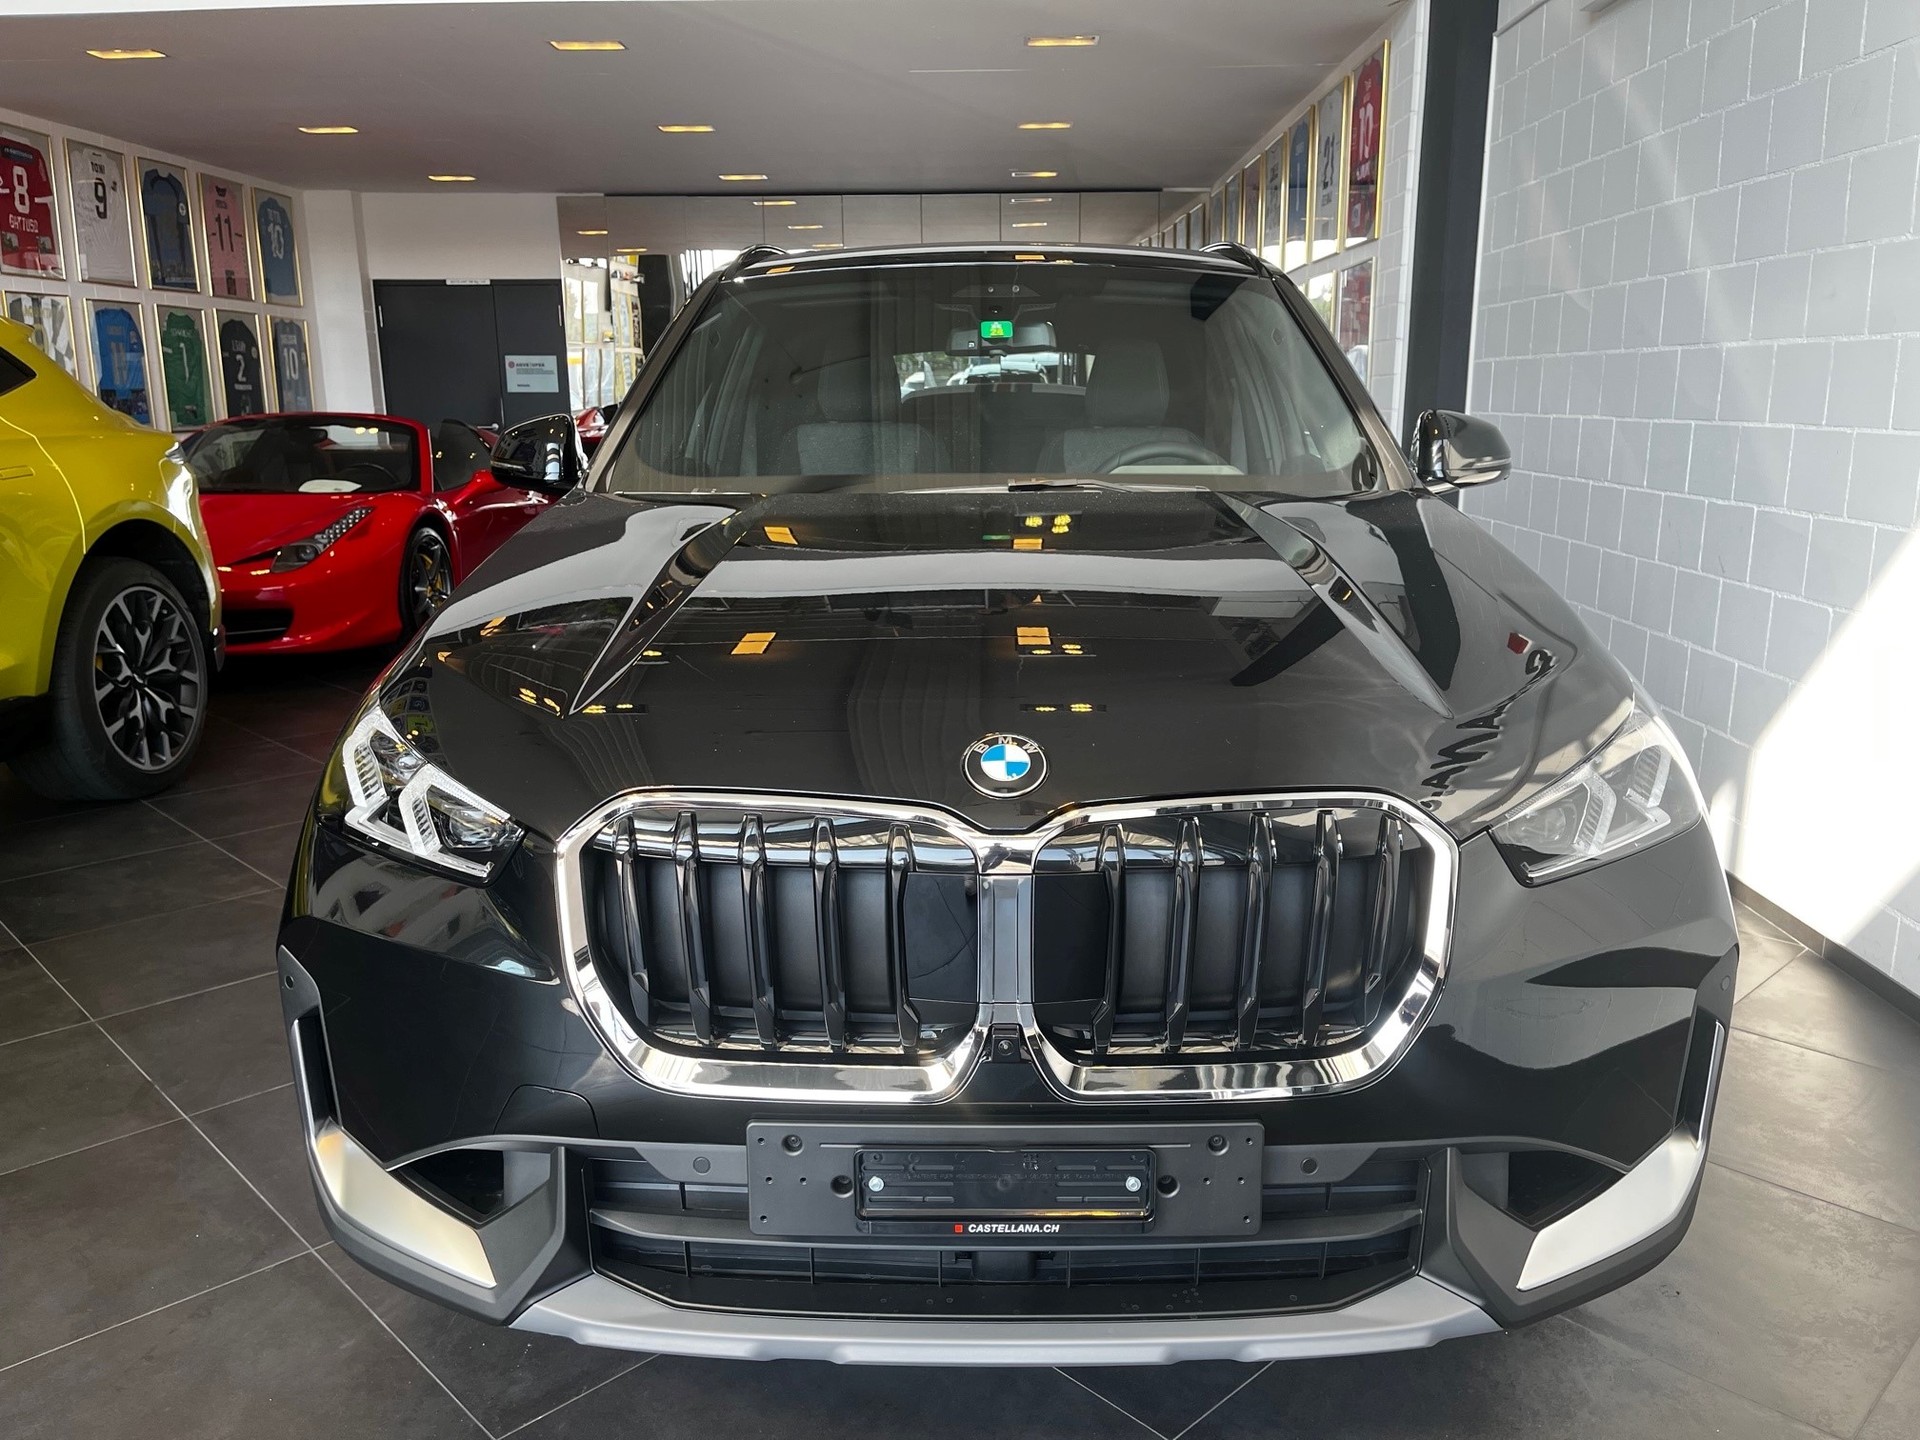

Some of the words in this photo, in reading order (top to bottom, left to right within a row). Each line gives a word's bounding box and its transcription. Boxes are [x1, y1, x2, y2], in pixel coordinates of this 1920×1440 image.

[12, 165, 30, 215] 8
[94, 177, 107, 219] 9
[214, 213, 234, 253] 11
[236, 353, 247, 382] 2
[283, 346, 299, 380] 10
[973, 735, 1039, 754] BMW
[967, 1223, 1060, 1233] CASTELLANA.CH
